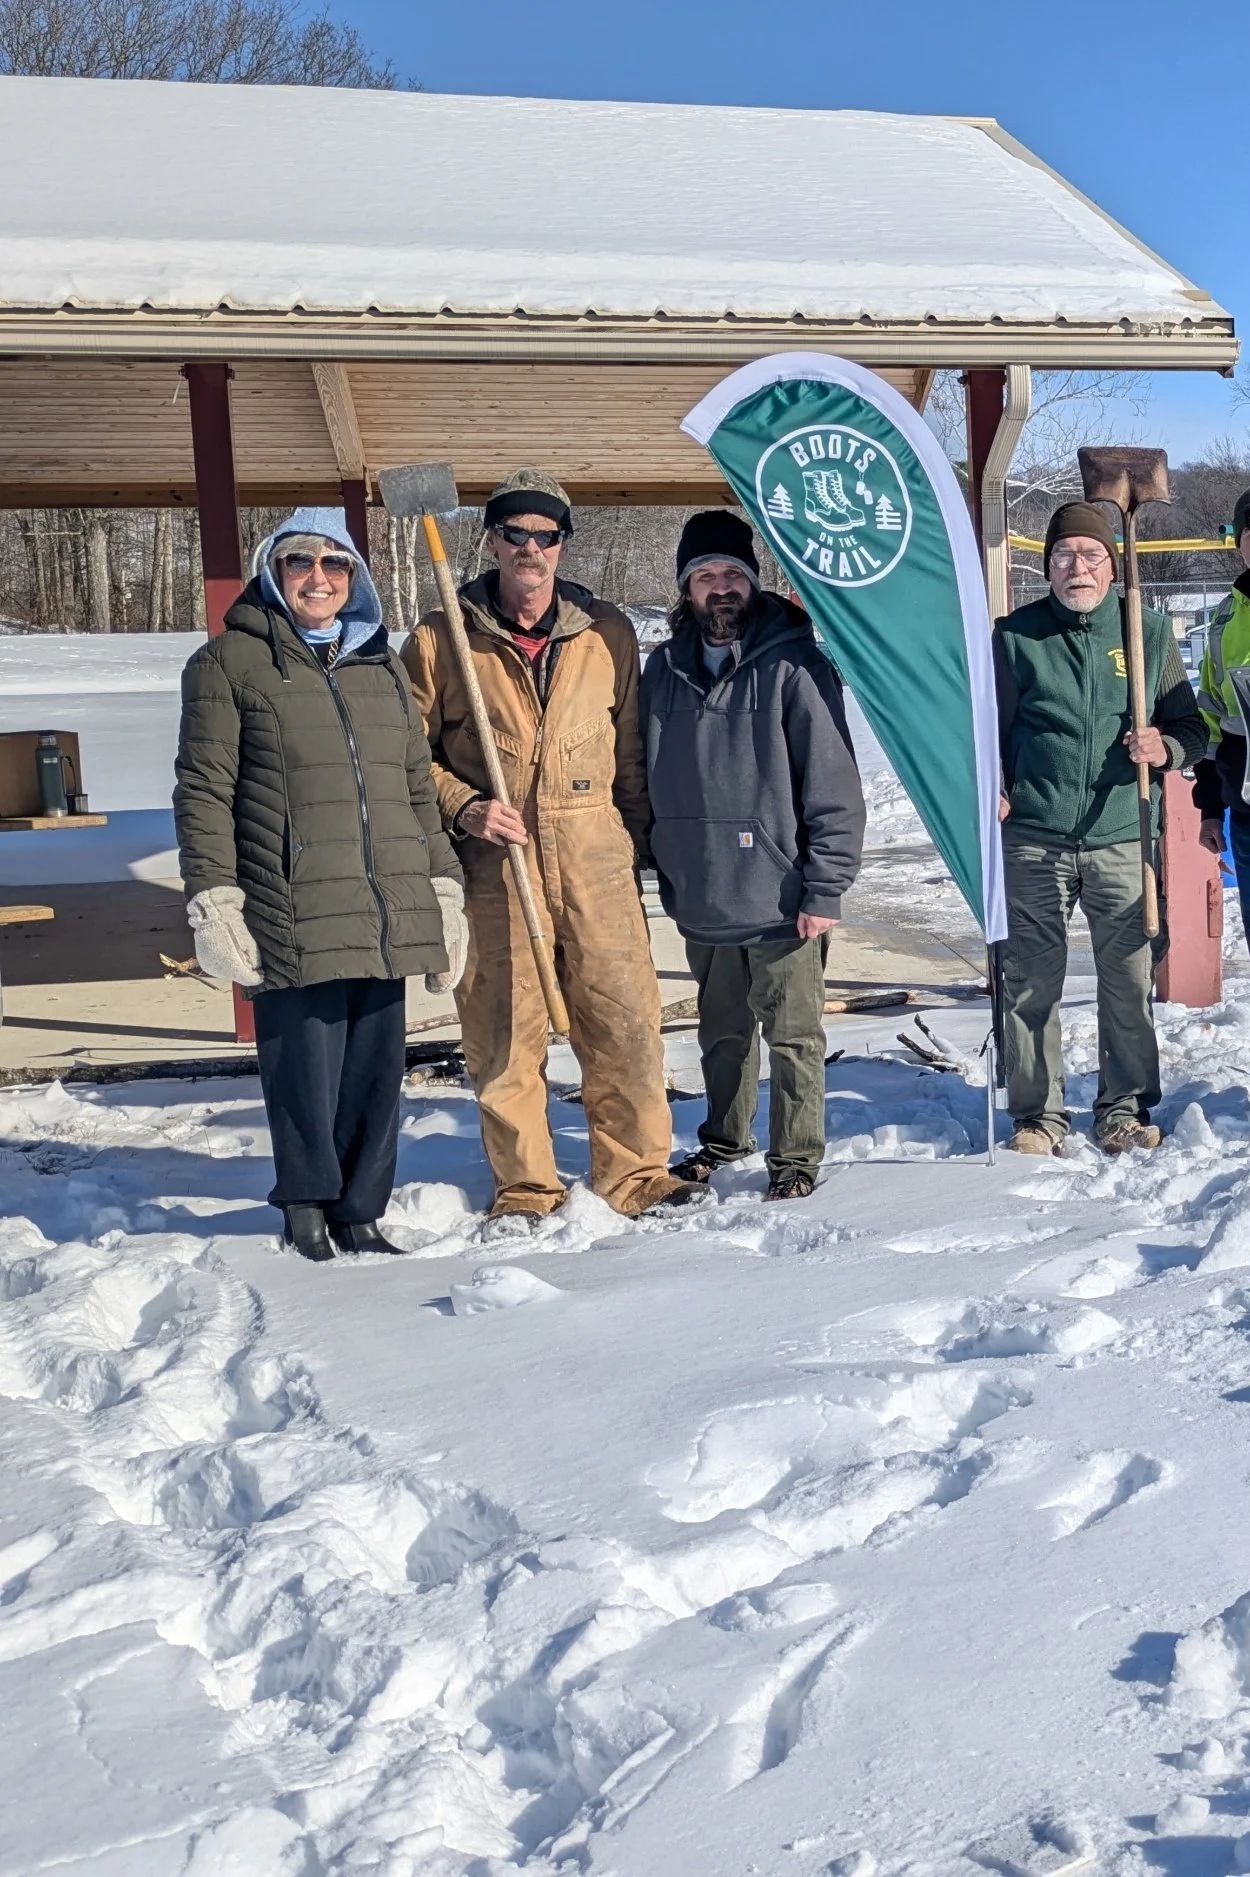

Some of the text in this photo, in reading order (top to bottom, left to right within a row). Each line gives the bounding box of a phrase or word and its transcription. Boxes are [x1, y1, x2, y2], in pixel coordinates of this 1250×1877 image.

[788, 434, 877, 473] BOOTS
[801, 537, 882, 578] TRAIL
[819, 532, 858, 548] ON THE
